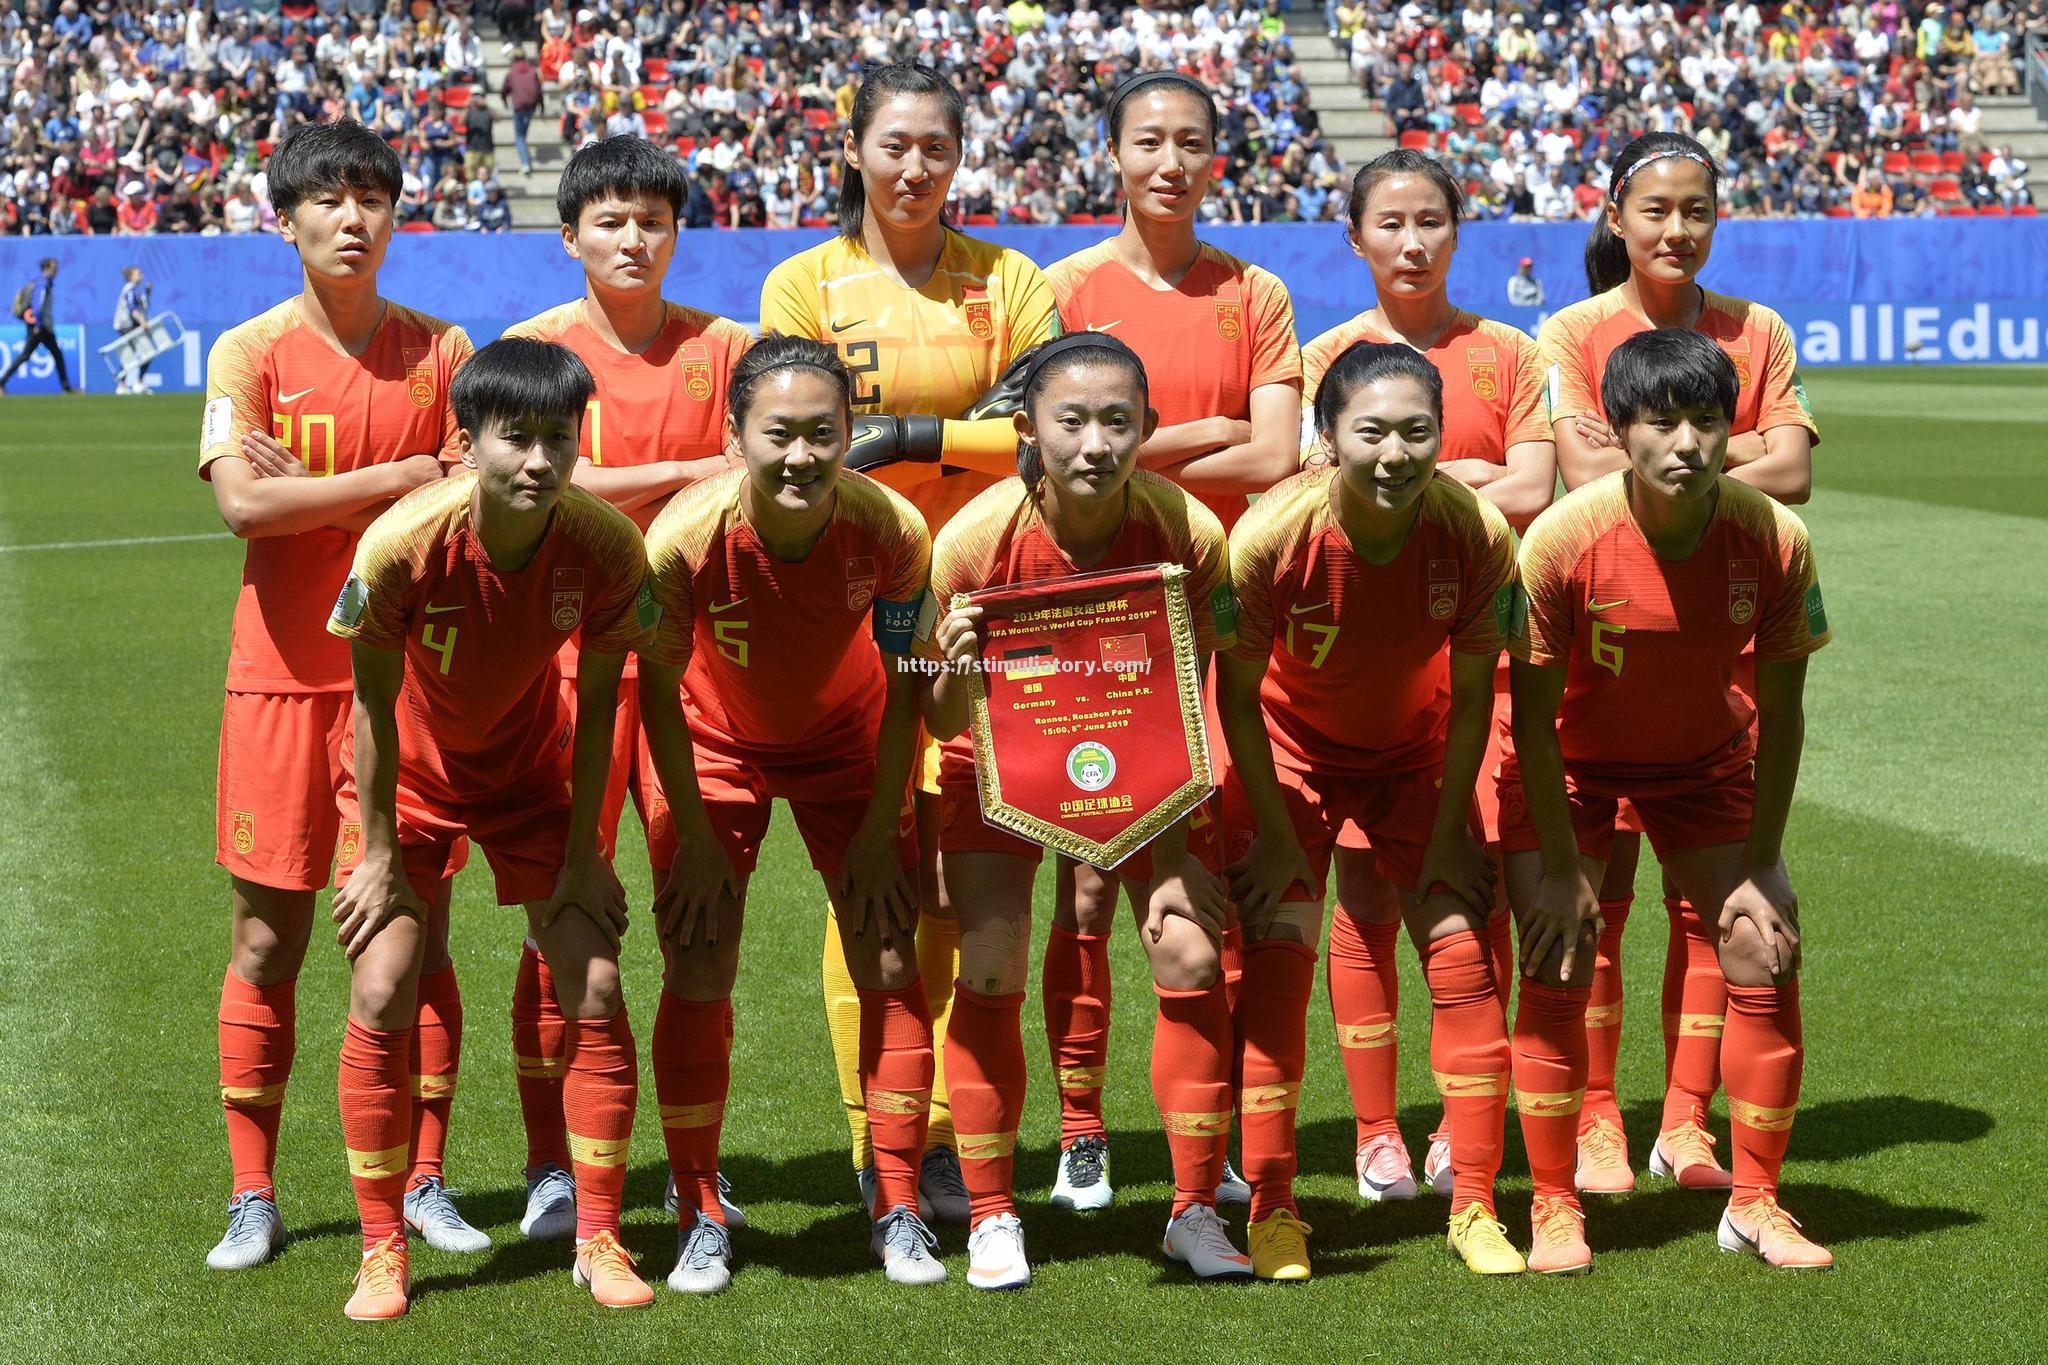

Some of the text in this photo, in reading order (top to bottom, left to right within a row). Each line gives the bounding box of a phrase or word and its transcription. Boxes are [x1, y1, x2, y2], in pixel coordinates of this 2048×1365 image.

[967, 304, 989, 313] CFA
[1217, 305, 1239, 314] CFA
[1788, 302, 2048, 363] allEdu
[408, 369, 432, 378] CFA
[684, 364, 708, 374] CFA
[1431, 585, 1456, 594] CFA
[1731, 585, 1756, 595] CFA
[555, 594, 580, 602] CFA
[1013, 599, 1129, 623] 2019年法国女足世界杯
[987, 630, 1007, 638] FIFA
[1008, 624, 1048, 636] Women's
[1049, 620, 1075, 630] World
[1076, 618, 1094, 627] Cup
[1095, 615, 1127, 625] France
[714, 620, 749, 669] 5
[1284, 613, 1340, 670] 17
[421, 623, 458, 676] 4
[1591, 620, 1626, 679] 6
[1117, 671, 1138, 683] 中国
[1022, 682, 1043, 695] 德国
[1013, 698, 1056, 711] Germany
[1106, 688, 1133, 700] China
[1135, 686, 1153, 696] P.R.
[1072, 710, 1110, 721] Roazhon
[1111, 707, 1133, 717] Park
[1042, 725, 1070, 737] 15:00,
[1083, 722, 1105, 732] June
[1106, 719, 1129, 729] 2019
[1060, 794, 1133, 813] 中国足球协会
[234, 813, 252, 824] CFA
[344, 825, 361, 835] CFA
